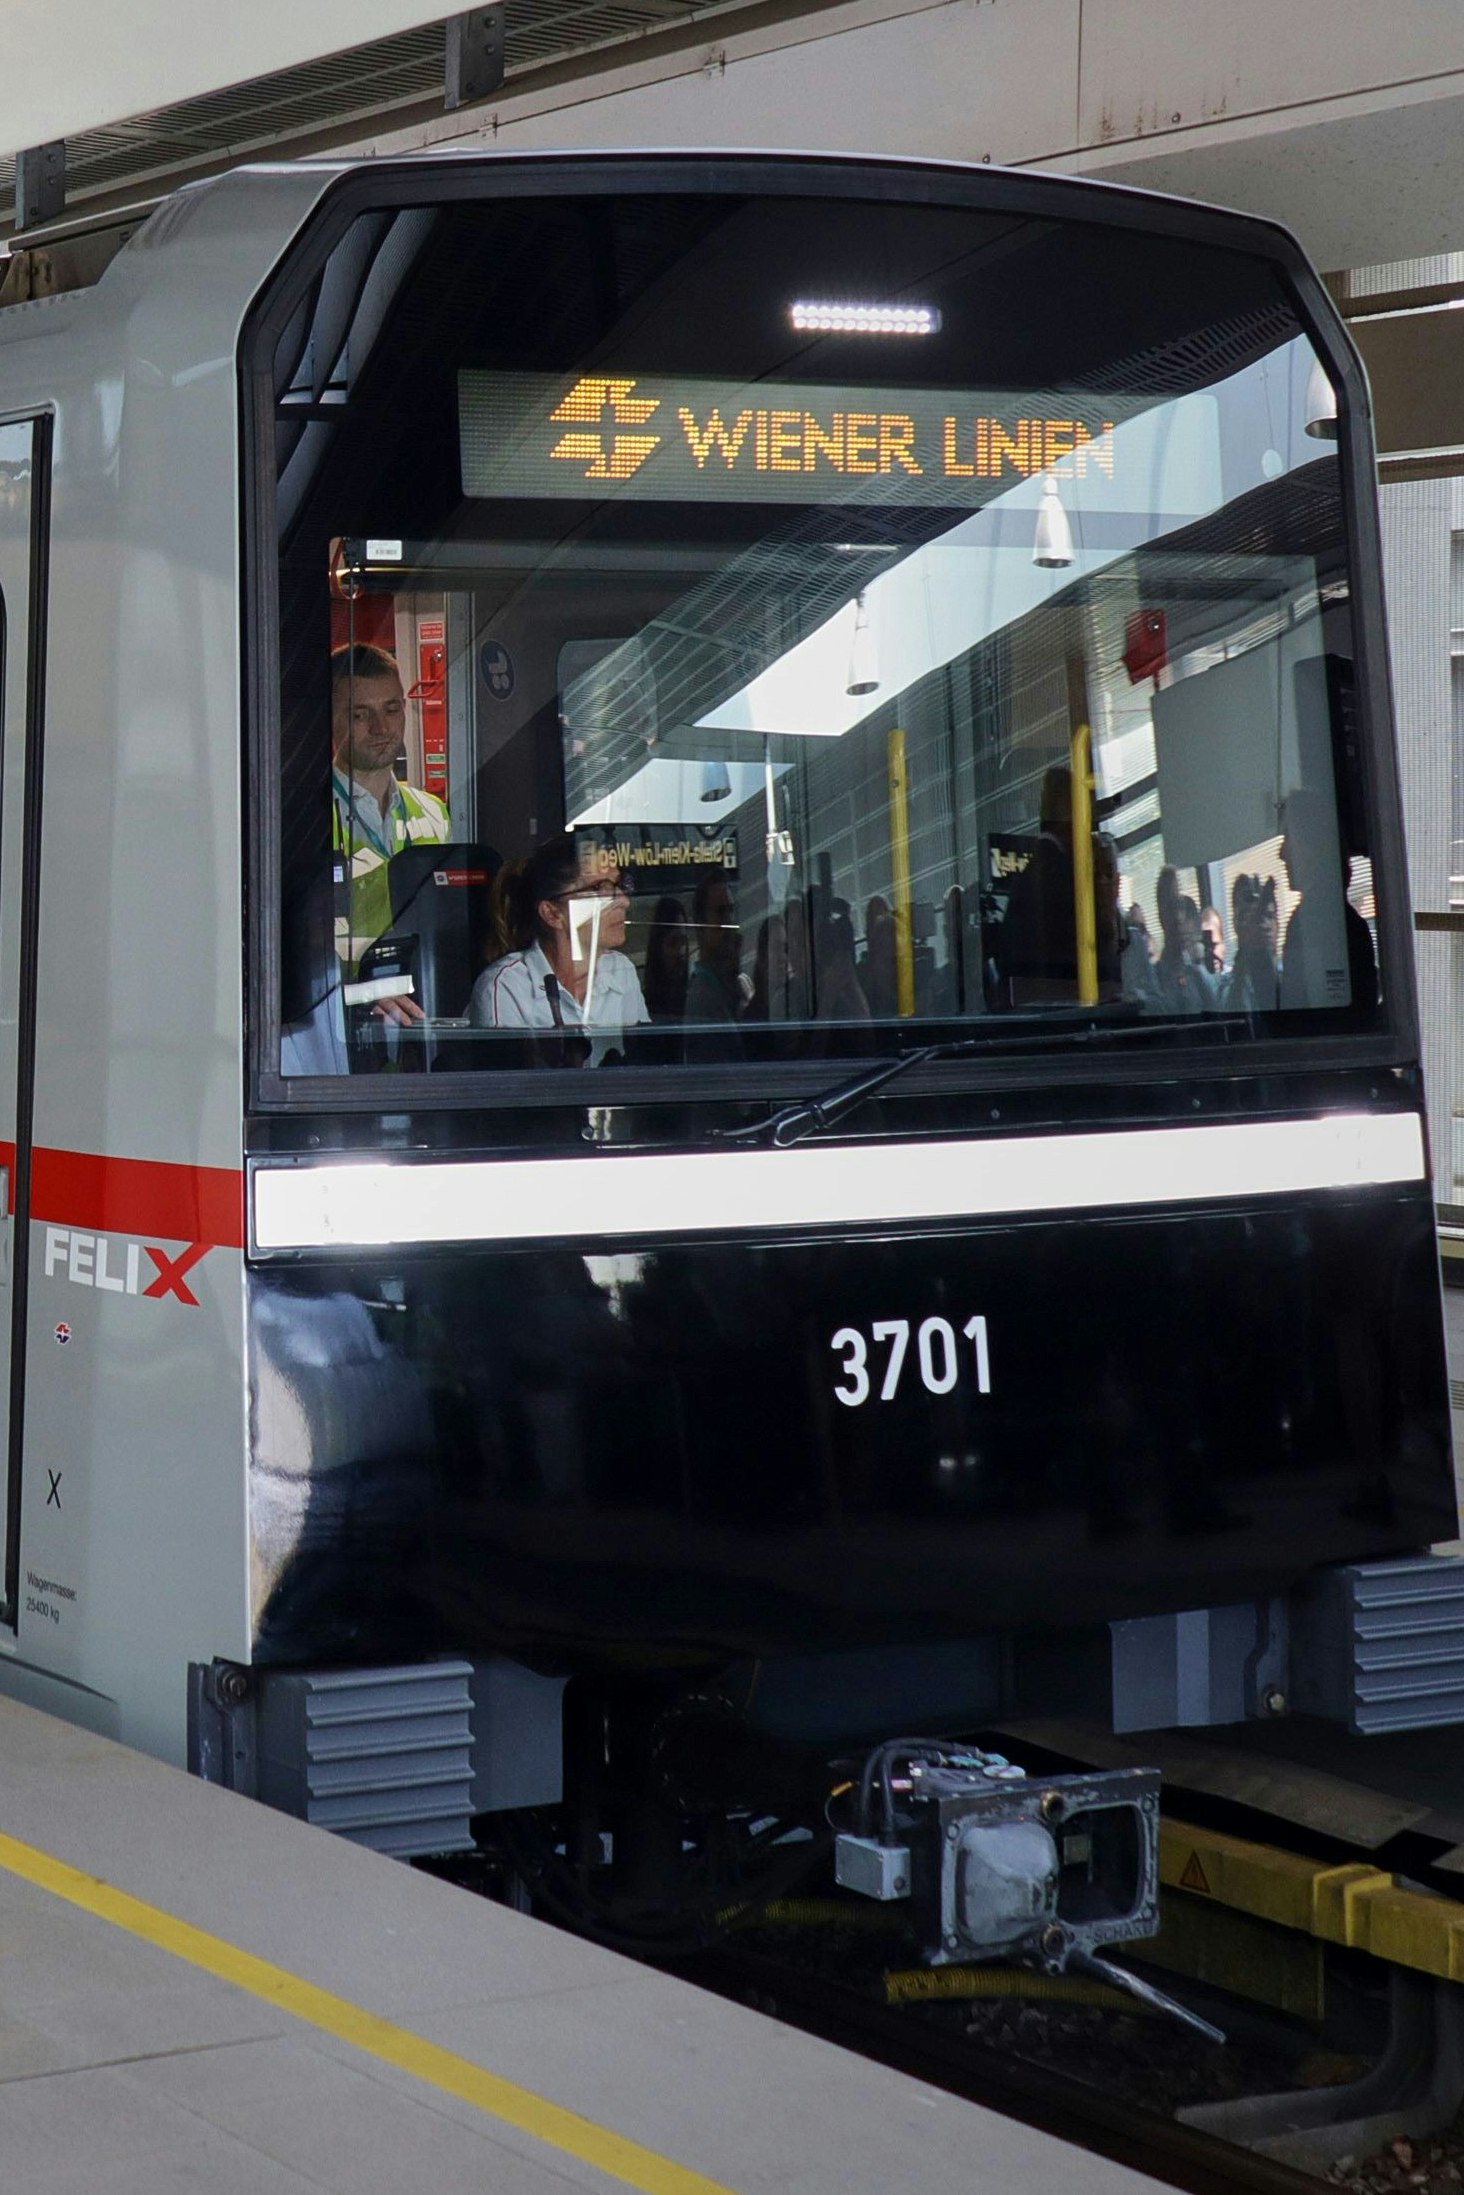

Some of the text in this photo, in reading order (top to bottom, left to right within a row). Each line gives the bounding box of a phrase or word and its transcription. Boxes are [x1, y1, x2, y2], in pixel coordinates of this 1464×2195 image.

[678, 406, 1115, 480] WIENER LINIEN
[44, 1226, 214, 1307] FELIX
[831, 1315, 991, 1407] 3701
[50, 1604, 60, 1625] kg
